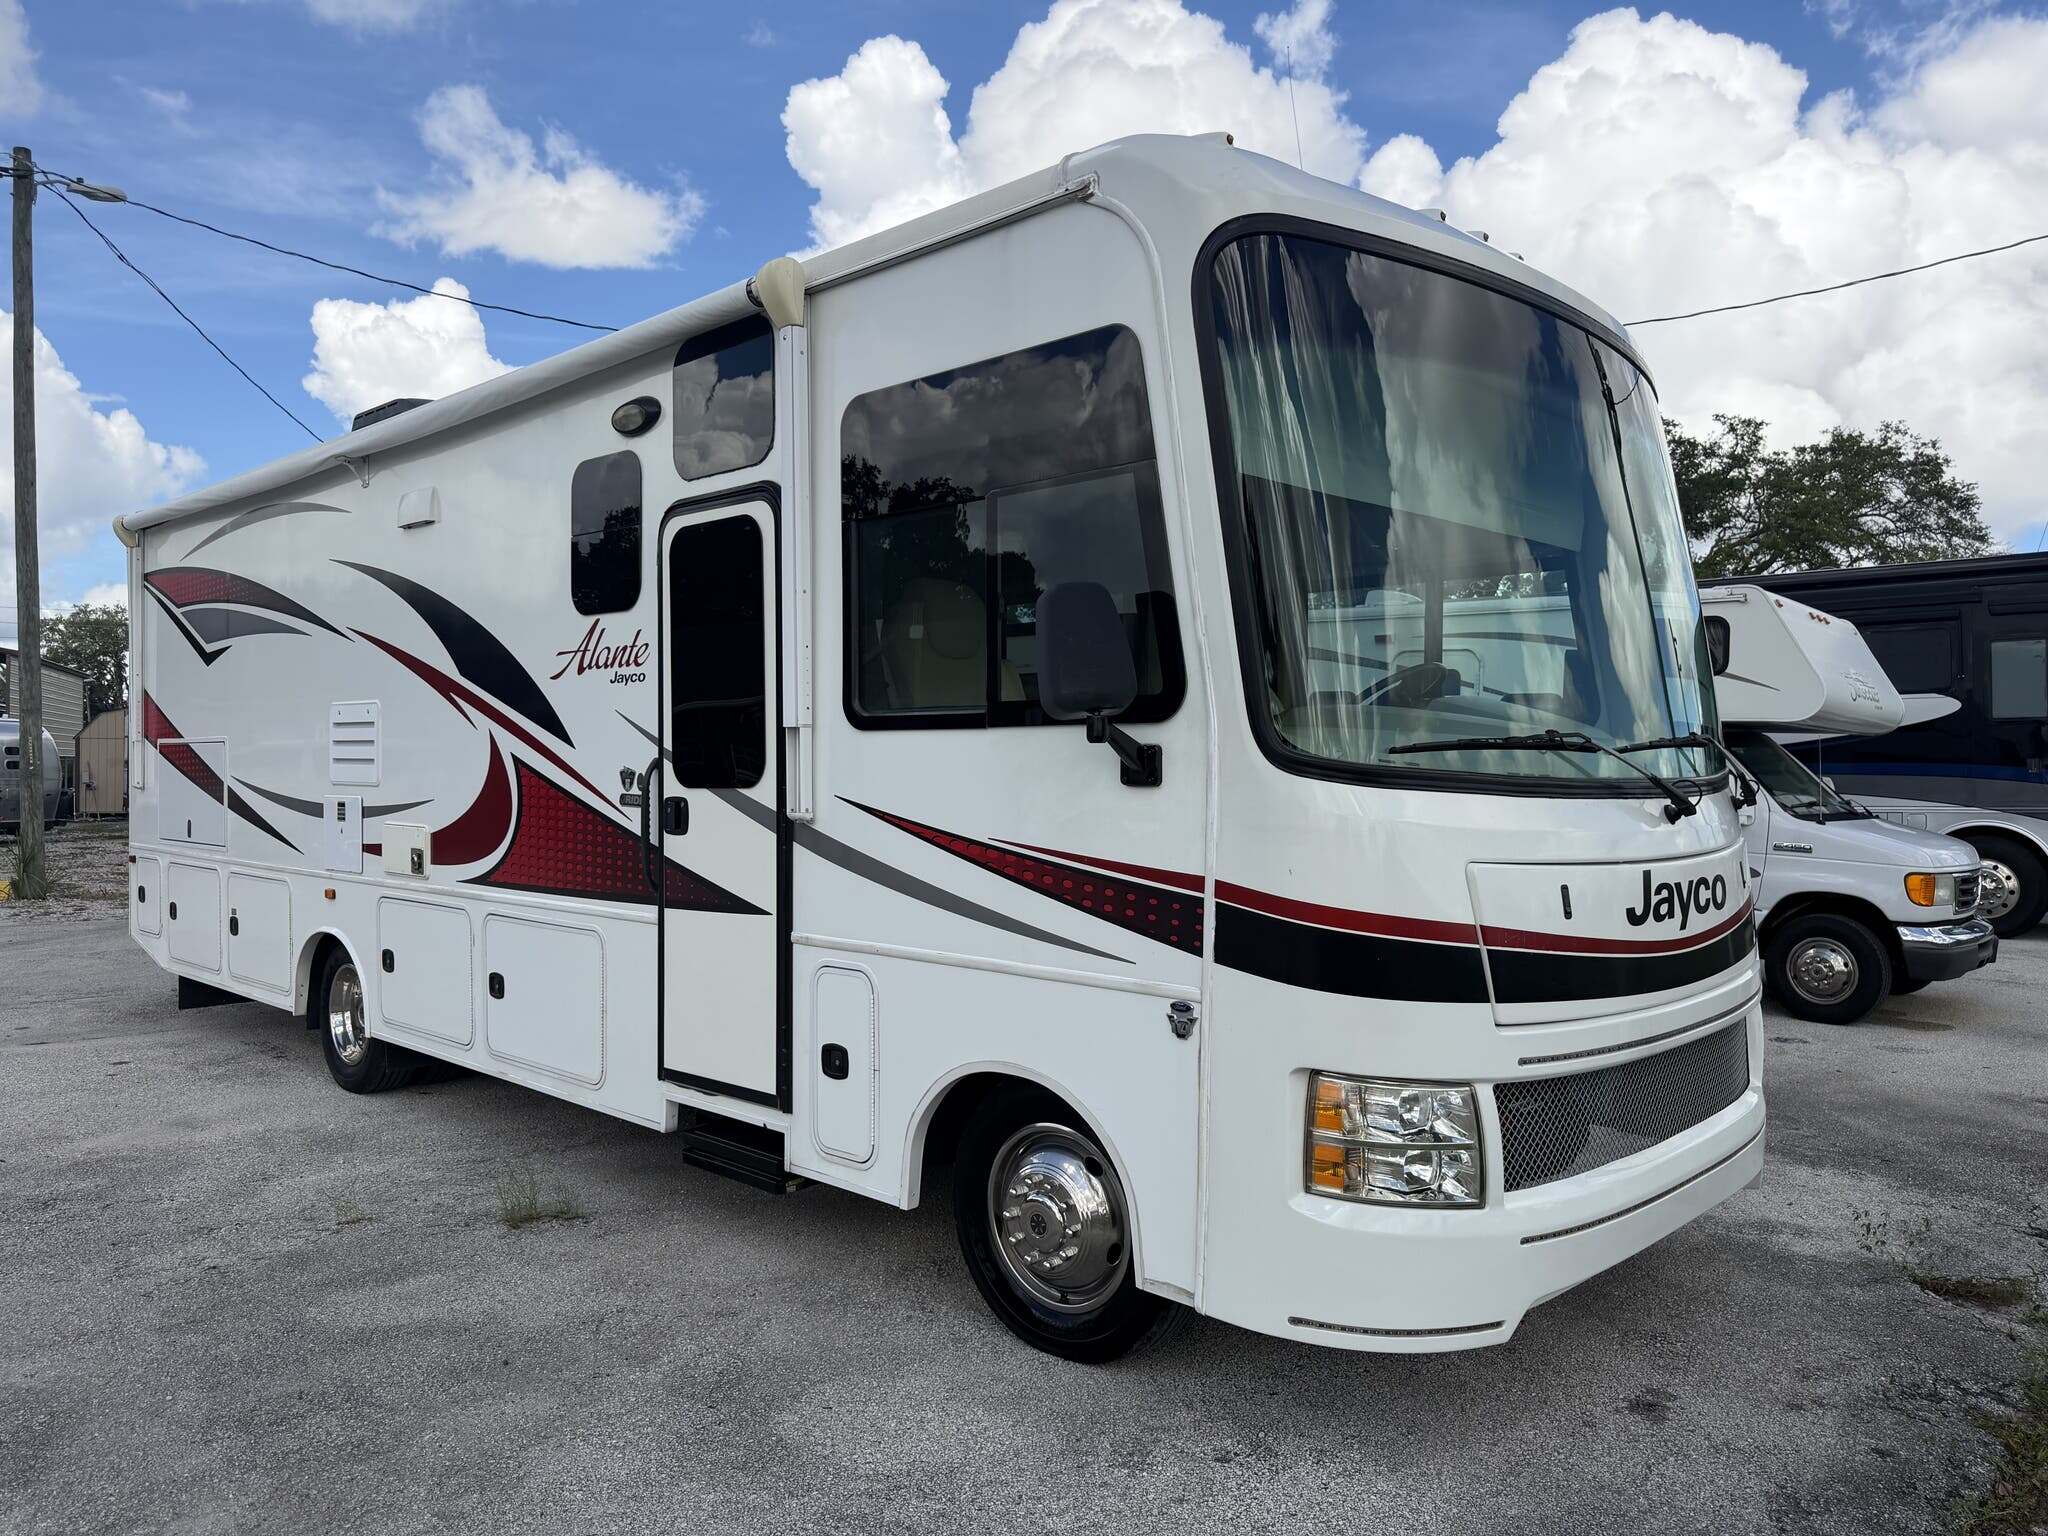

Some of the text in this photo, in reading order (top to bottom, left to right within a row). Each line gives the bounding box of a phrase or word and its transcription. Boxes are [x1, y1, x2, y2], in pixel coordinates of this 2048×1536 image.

[550, 618, 650, 680] Alante
[609, 671, 646, 686] Jayco
[1626, 869, 1726, 931] Jayco
